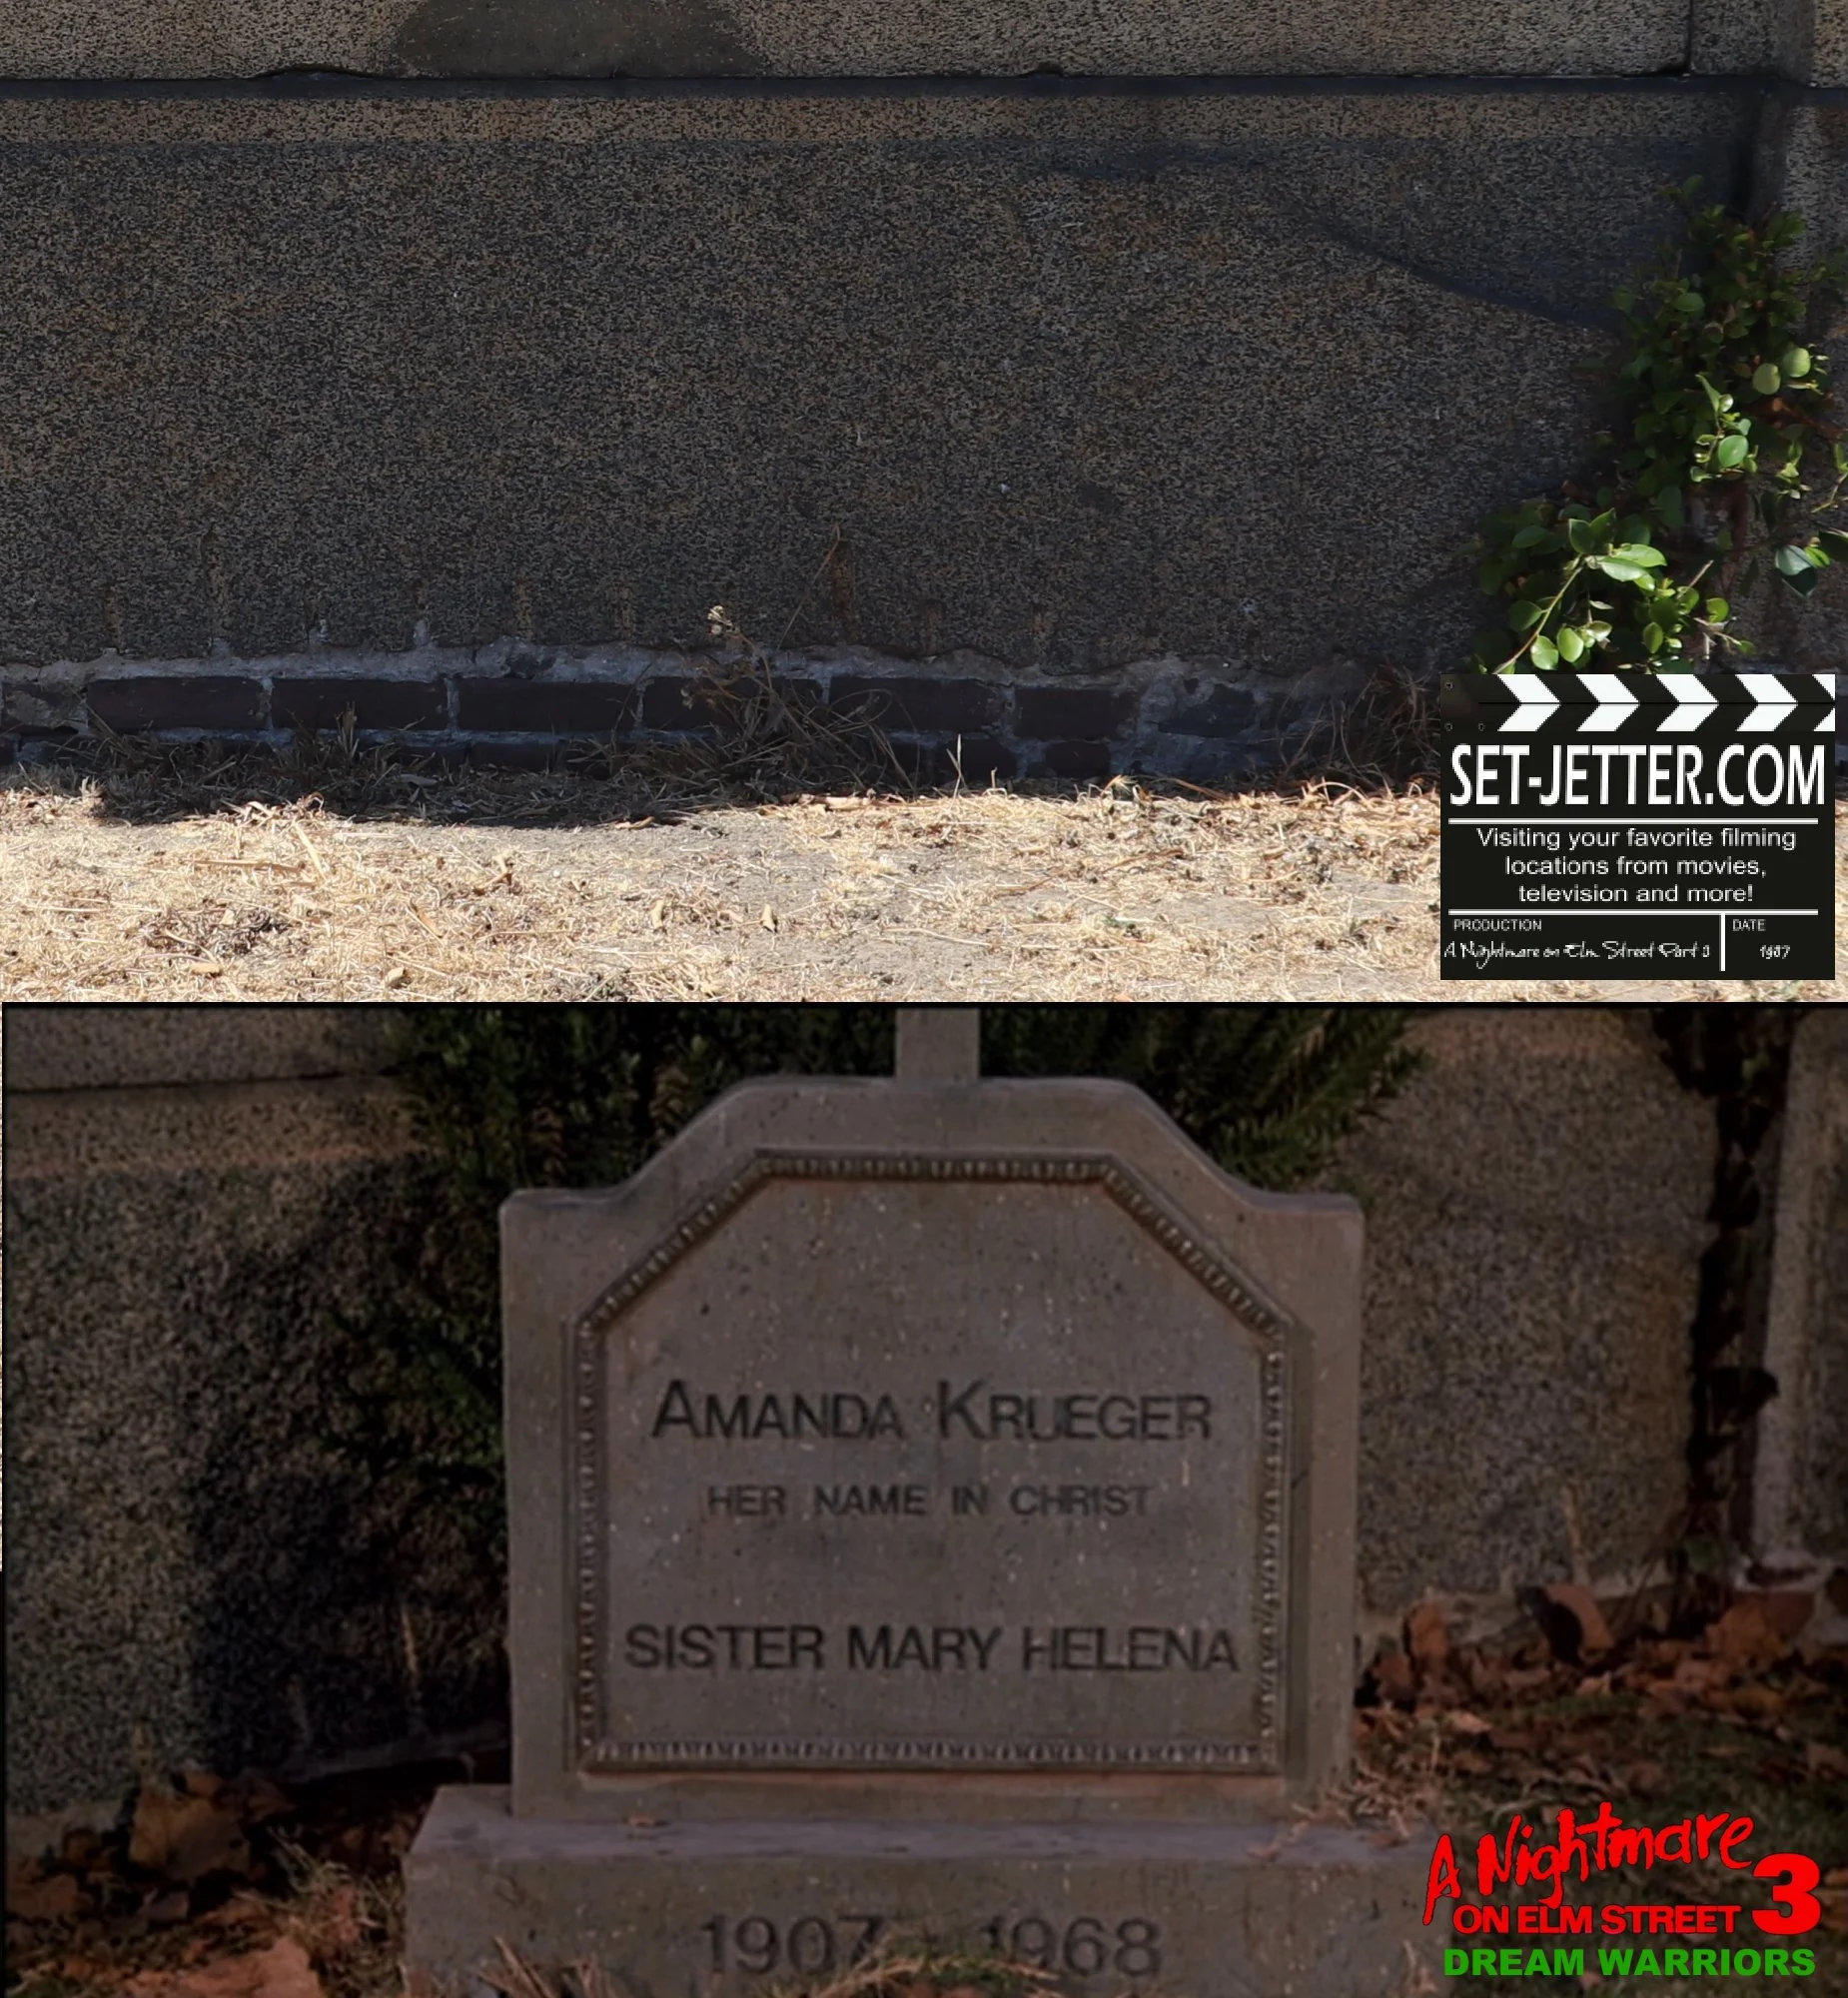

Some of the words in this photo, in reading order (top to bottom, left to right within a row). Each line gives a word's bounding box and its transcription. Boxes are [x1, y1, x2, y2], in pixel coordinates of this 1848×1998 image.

[707, 1486, 788, 1516] HER
[813, 1486, 927, 1516] NAME
[950, 1486, 989, 1516] IN
[1009, 1485, 1151, 1516] CHRIST
[624, 1624, 826, 1670] SISTER
[846, 1625, 1004, 1671] MARY
[1021, 1625, 1240, 1672] HELENA
[702, 1914, 885, 1975] 1907
